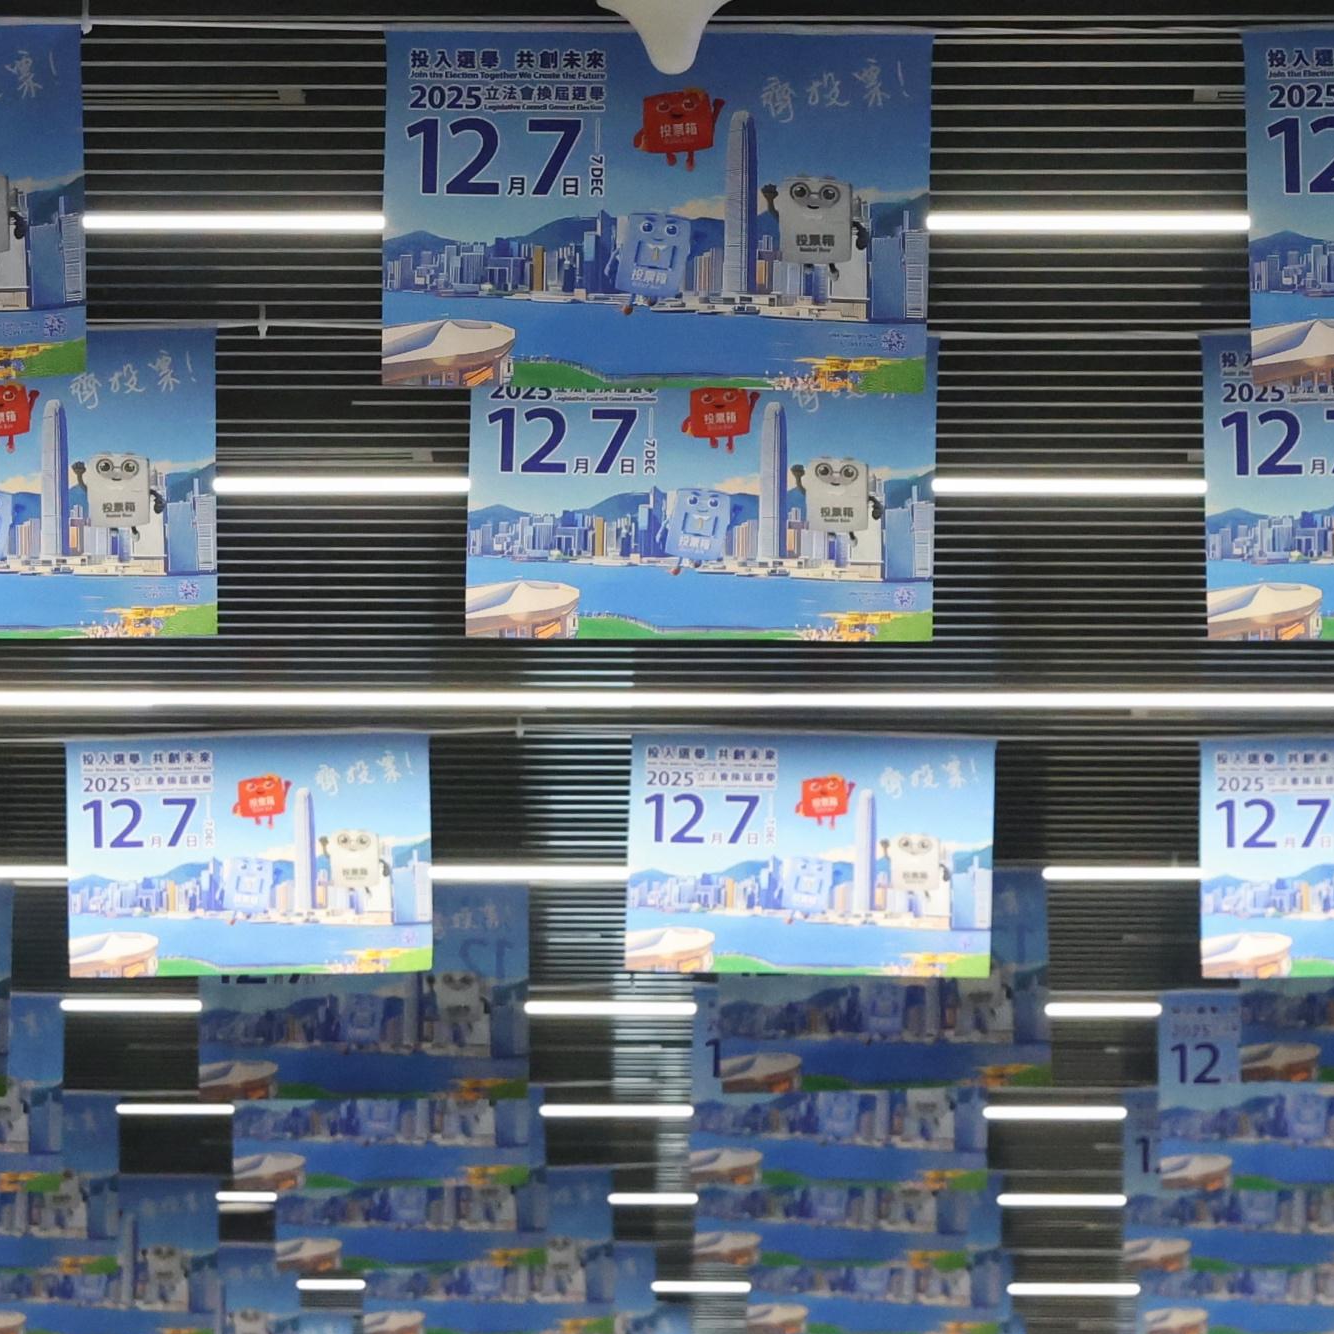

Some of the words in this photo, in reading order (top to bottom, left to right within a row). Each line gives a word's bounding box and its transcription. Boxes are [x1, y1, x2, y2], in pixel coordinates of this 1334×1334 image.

[411, 50, 499, 69] 投入選舉
[517, 50, 604, 69] 共創未來
[411, 71, 428, 79] Join
[430, 71, 443, 79] the
[445, 71, 478, 79] Election
[481, 71, 517, 80] Together
[519, 72, 532, 80] We
[533, 72, 559, 80] Create
[562, 72, 575, 80] the
[578, 72, 605, 80] Future
[410, 86, 482, 109] 2025
[485, 86, 605, 101] 立法會換屆選舉
[660, 122, 698, 138] 投票箱
[591, 156, 603, 164] 7
[591, 167, 603, 196] DEC
[796, 234, 835, 246] 投票箱
[645, 450, 656, 474] DEC
[102, 501, 136, 513] 投票箱
[821, 506, 854, 517] 投票箱
[83, 777, 131, 793] 2025
[646, 771, 694, 787] 2025
[1217, 777, 1265, 793] 2025
